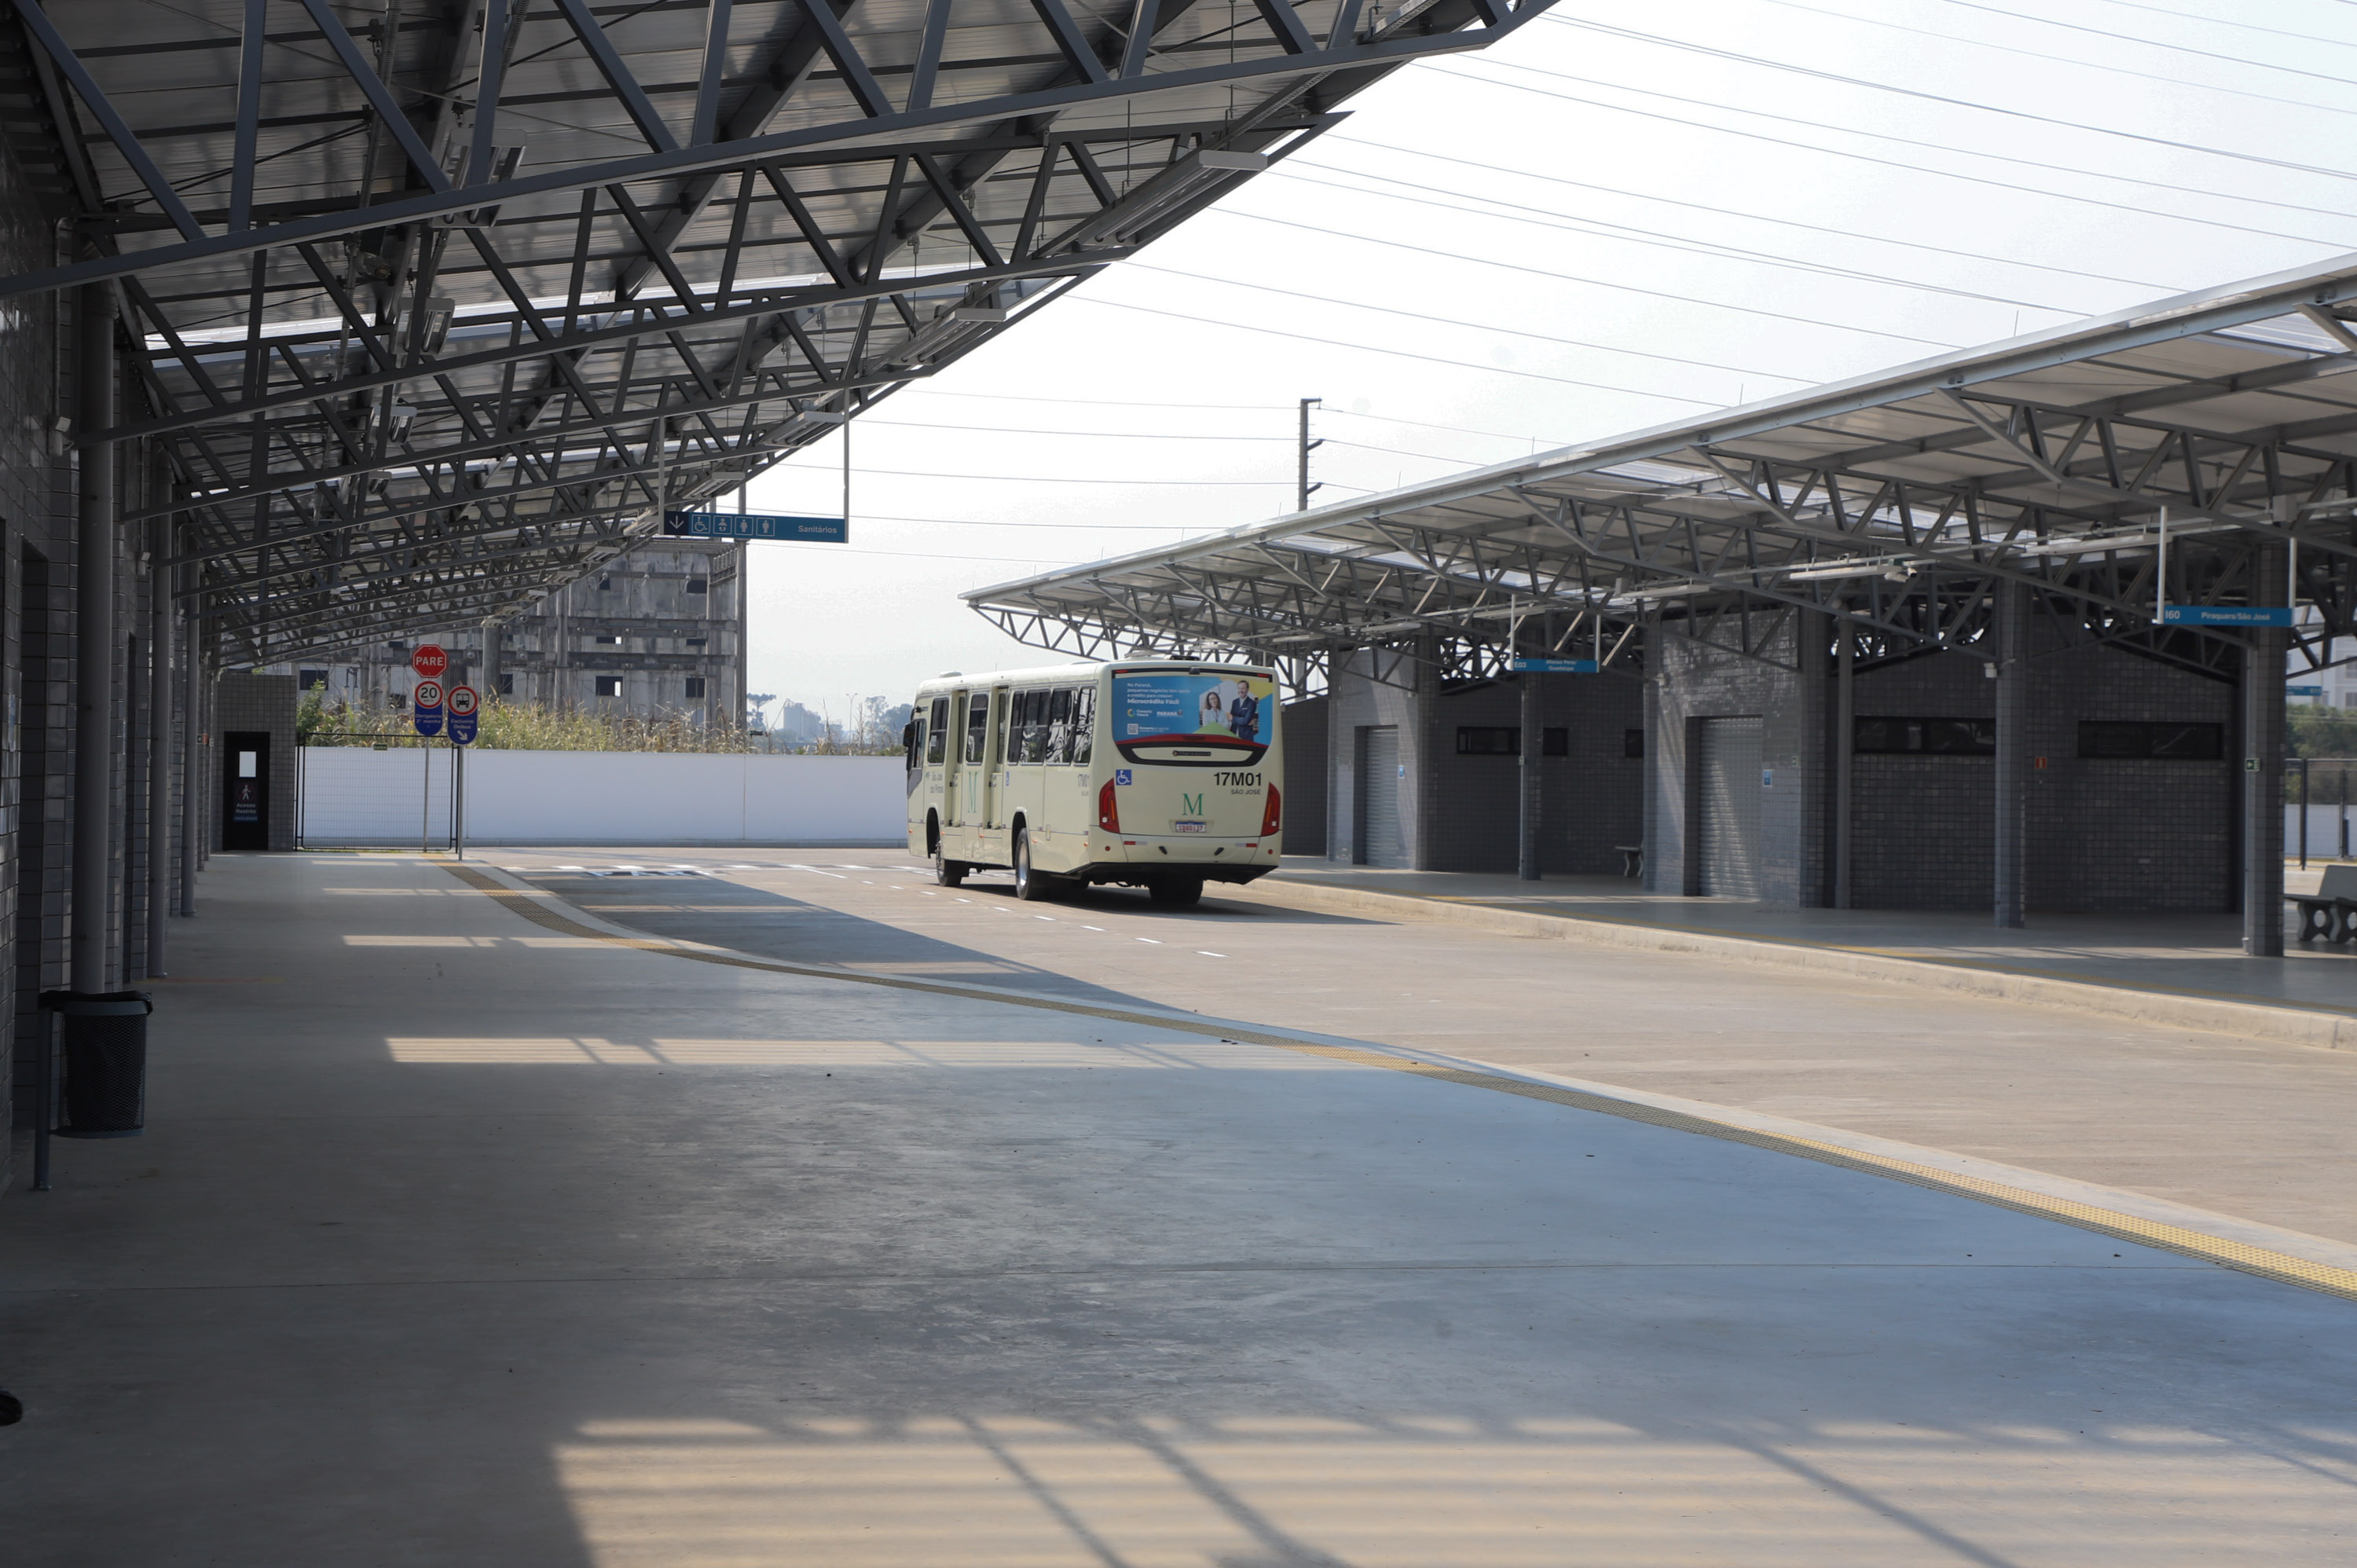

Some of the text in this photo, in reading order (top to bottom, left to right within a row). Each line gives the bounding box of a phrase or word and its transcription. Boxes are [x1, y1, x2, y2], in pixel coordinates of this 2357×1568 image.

[798, 525, 838, 534] Sanitários
[416, 657, 444, 666] PARE
[420, 687, 438, 698] 20
[1214, 772, 1262, 786] 17M01
[1182, 793, 1204, 816] M
